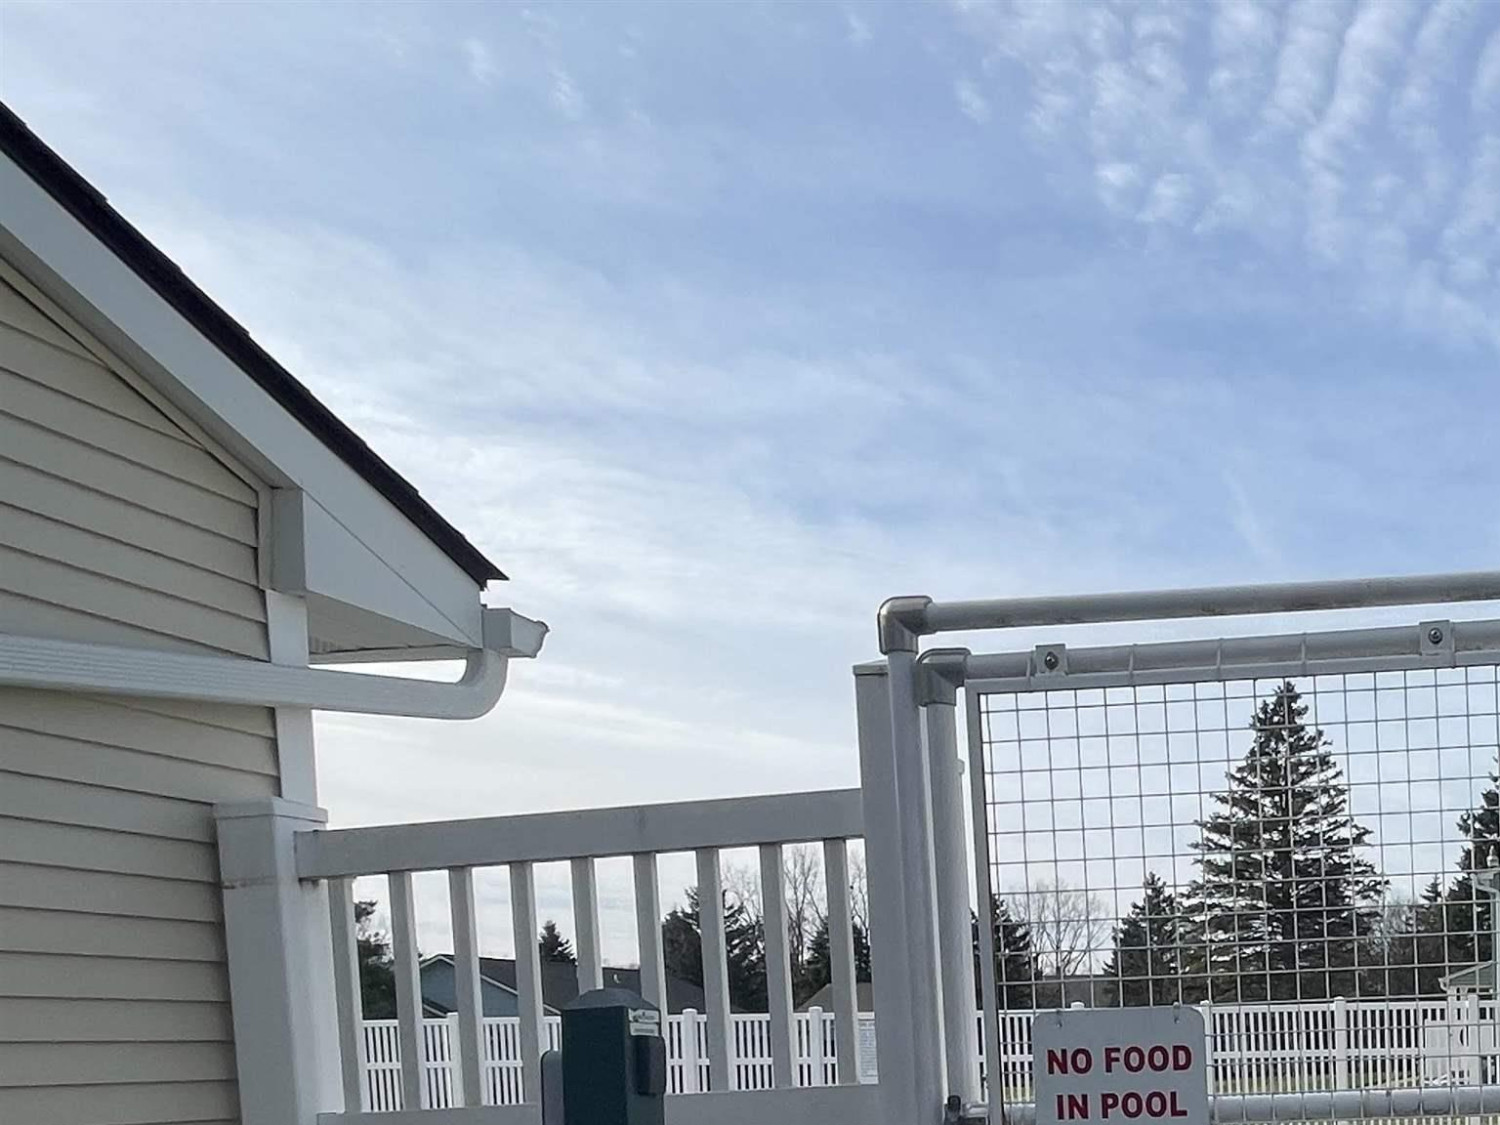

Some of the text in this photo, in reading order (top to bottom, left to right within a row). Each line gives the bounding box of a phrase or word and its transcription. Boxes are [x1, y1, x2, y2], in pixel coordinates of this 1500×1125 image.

[1047, 1045, 1192, 1075] NO FOOD
[1056, 1091, 1188, 1120] IN POOL
